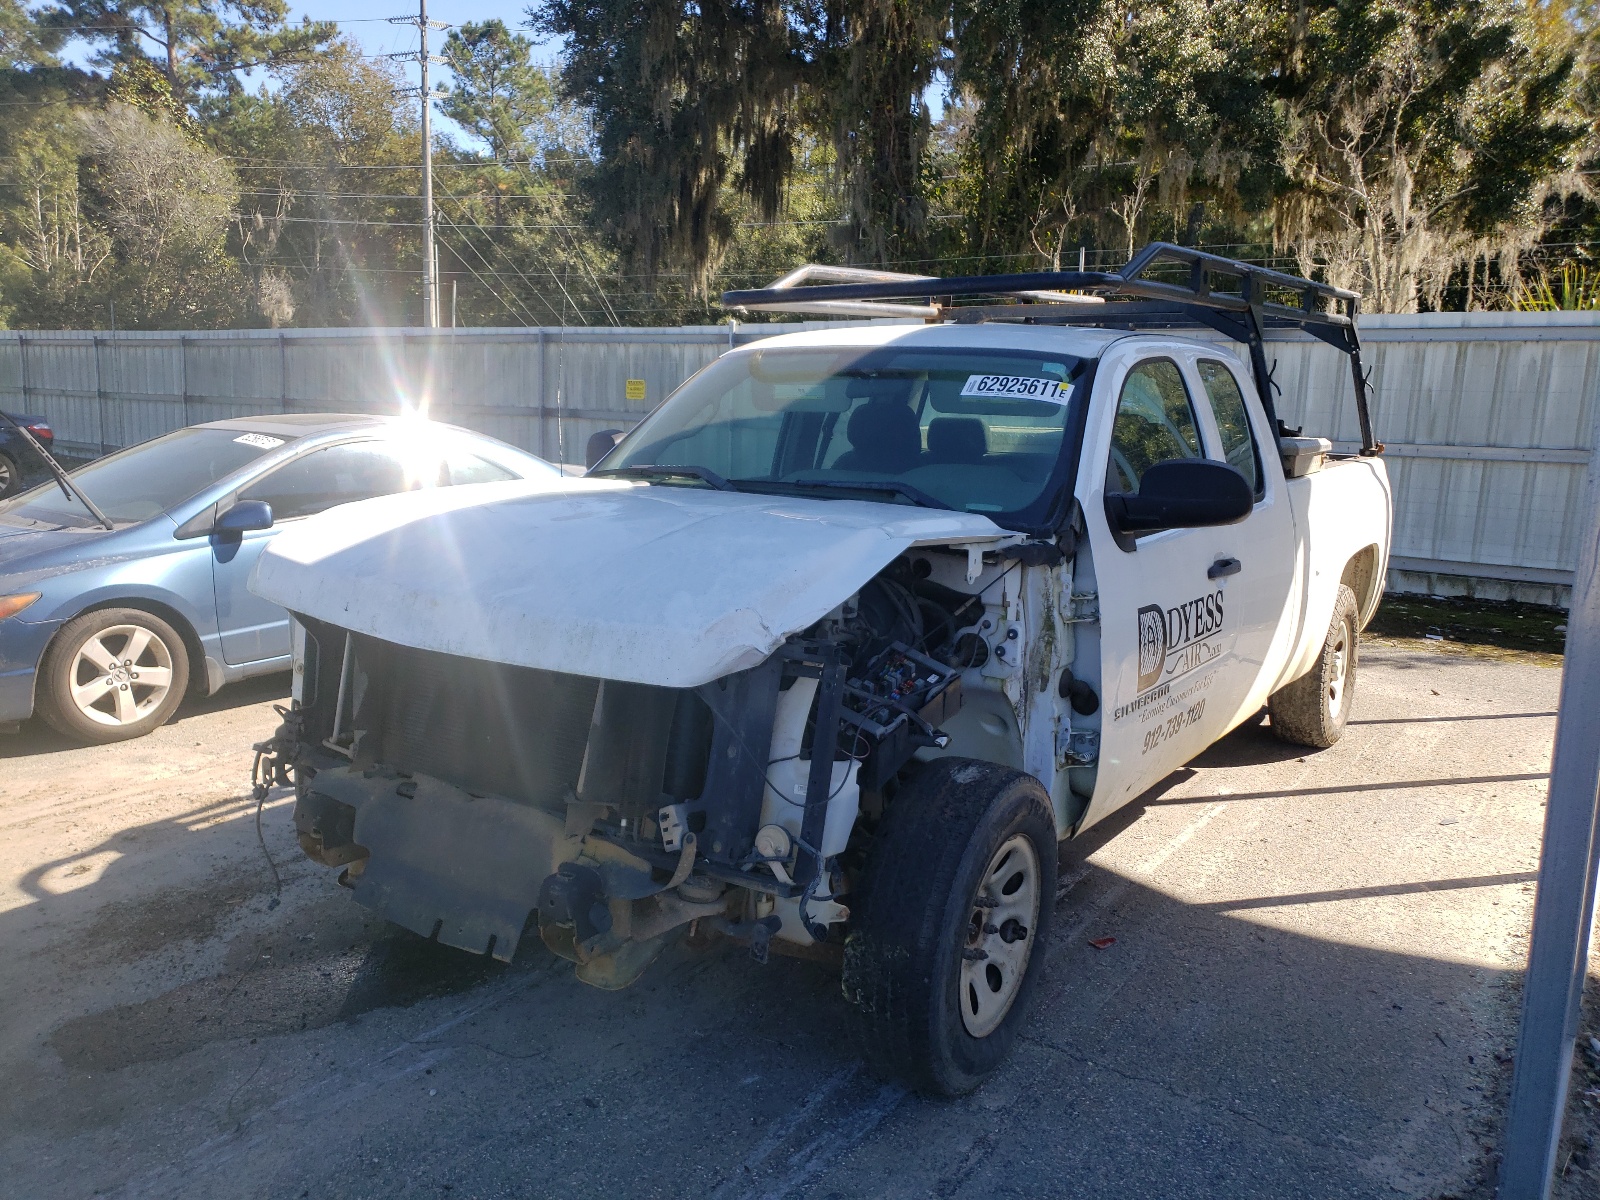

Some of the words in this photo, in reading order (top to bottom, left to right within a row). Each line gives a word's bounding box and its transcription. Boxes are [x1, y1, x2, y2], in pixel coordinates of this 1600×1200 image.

[977, 376, 1060, 398] 62925611
[1059, 388, 1067, 399] E
[1166, 589, 1224, 651] DYESS
[1182, 642, 1202, 673] AIR
[1141, 698, 1206, 756] 912-739-1120
